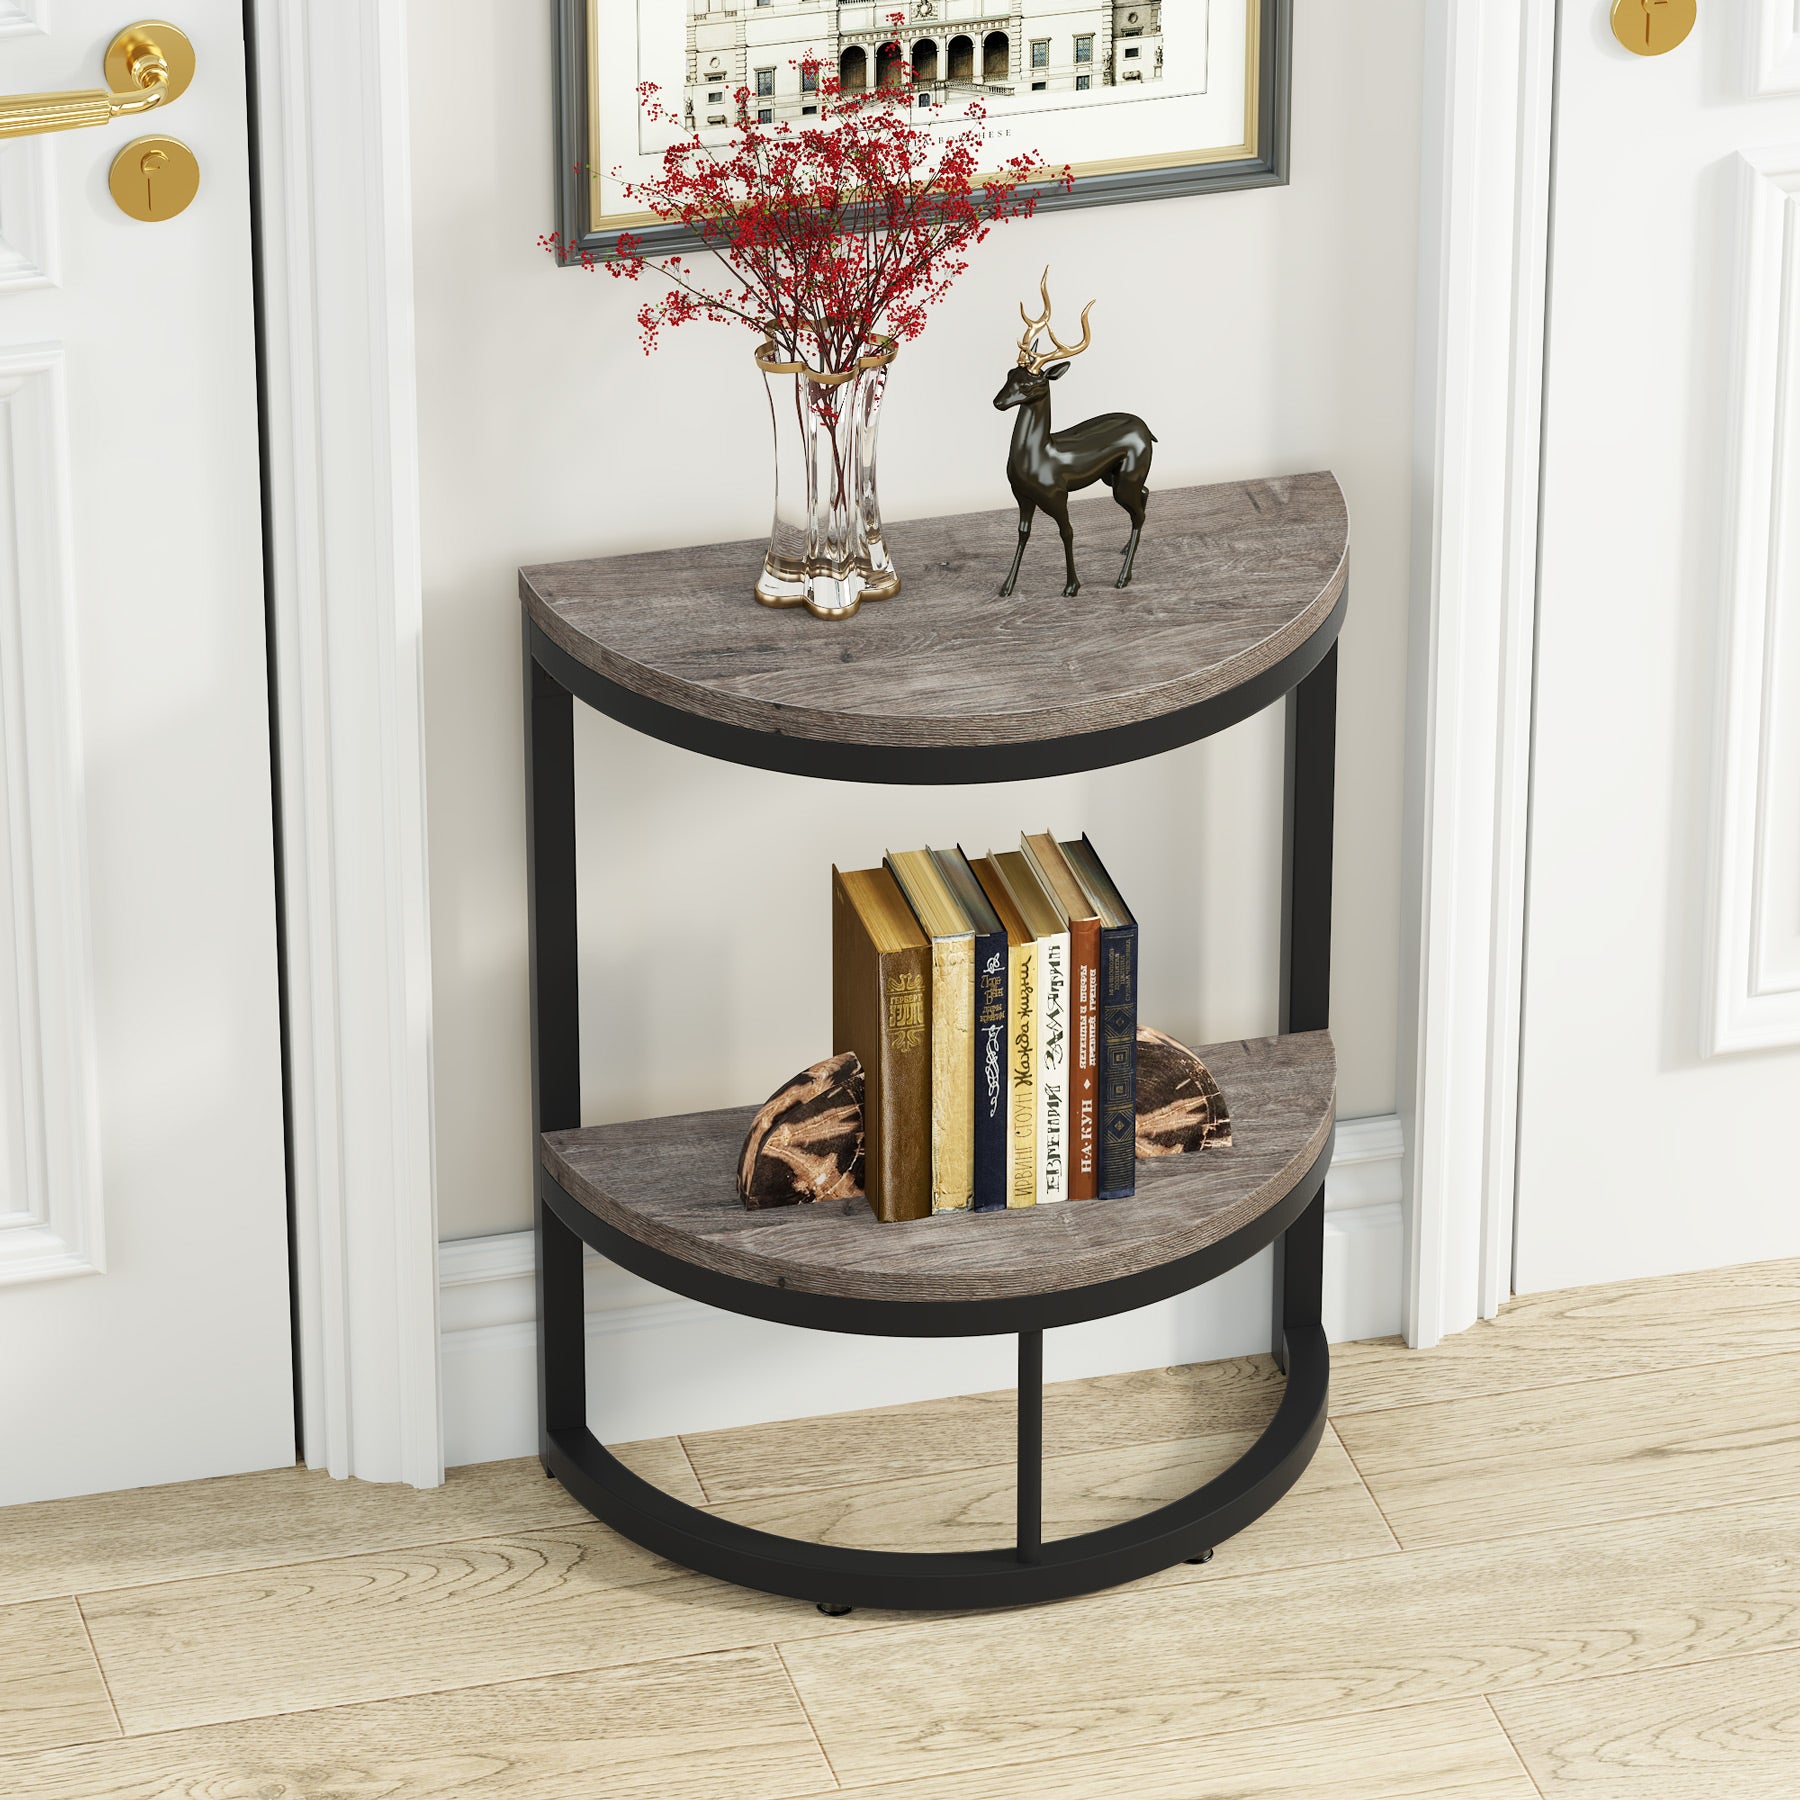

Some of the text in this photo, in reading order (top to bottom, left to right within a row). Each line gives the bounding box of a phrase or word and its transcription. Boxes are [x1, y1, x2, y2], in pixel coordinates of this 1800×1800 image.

[938, 129, 1011, 144] BORHESE
[890, 993, 923, 1005] ГЕРБЕРТ
[1013, 955, 1033, 1088] Жажда жизни
[1044, 945, 1064, 1194] ЕВГЕНИЙ ЗАМЯТИН
[1014, 1092, 1033, 1197] ИРВИНГ СТОУН
